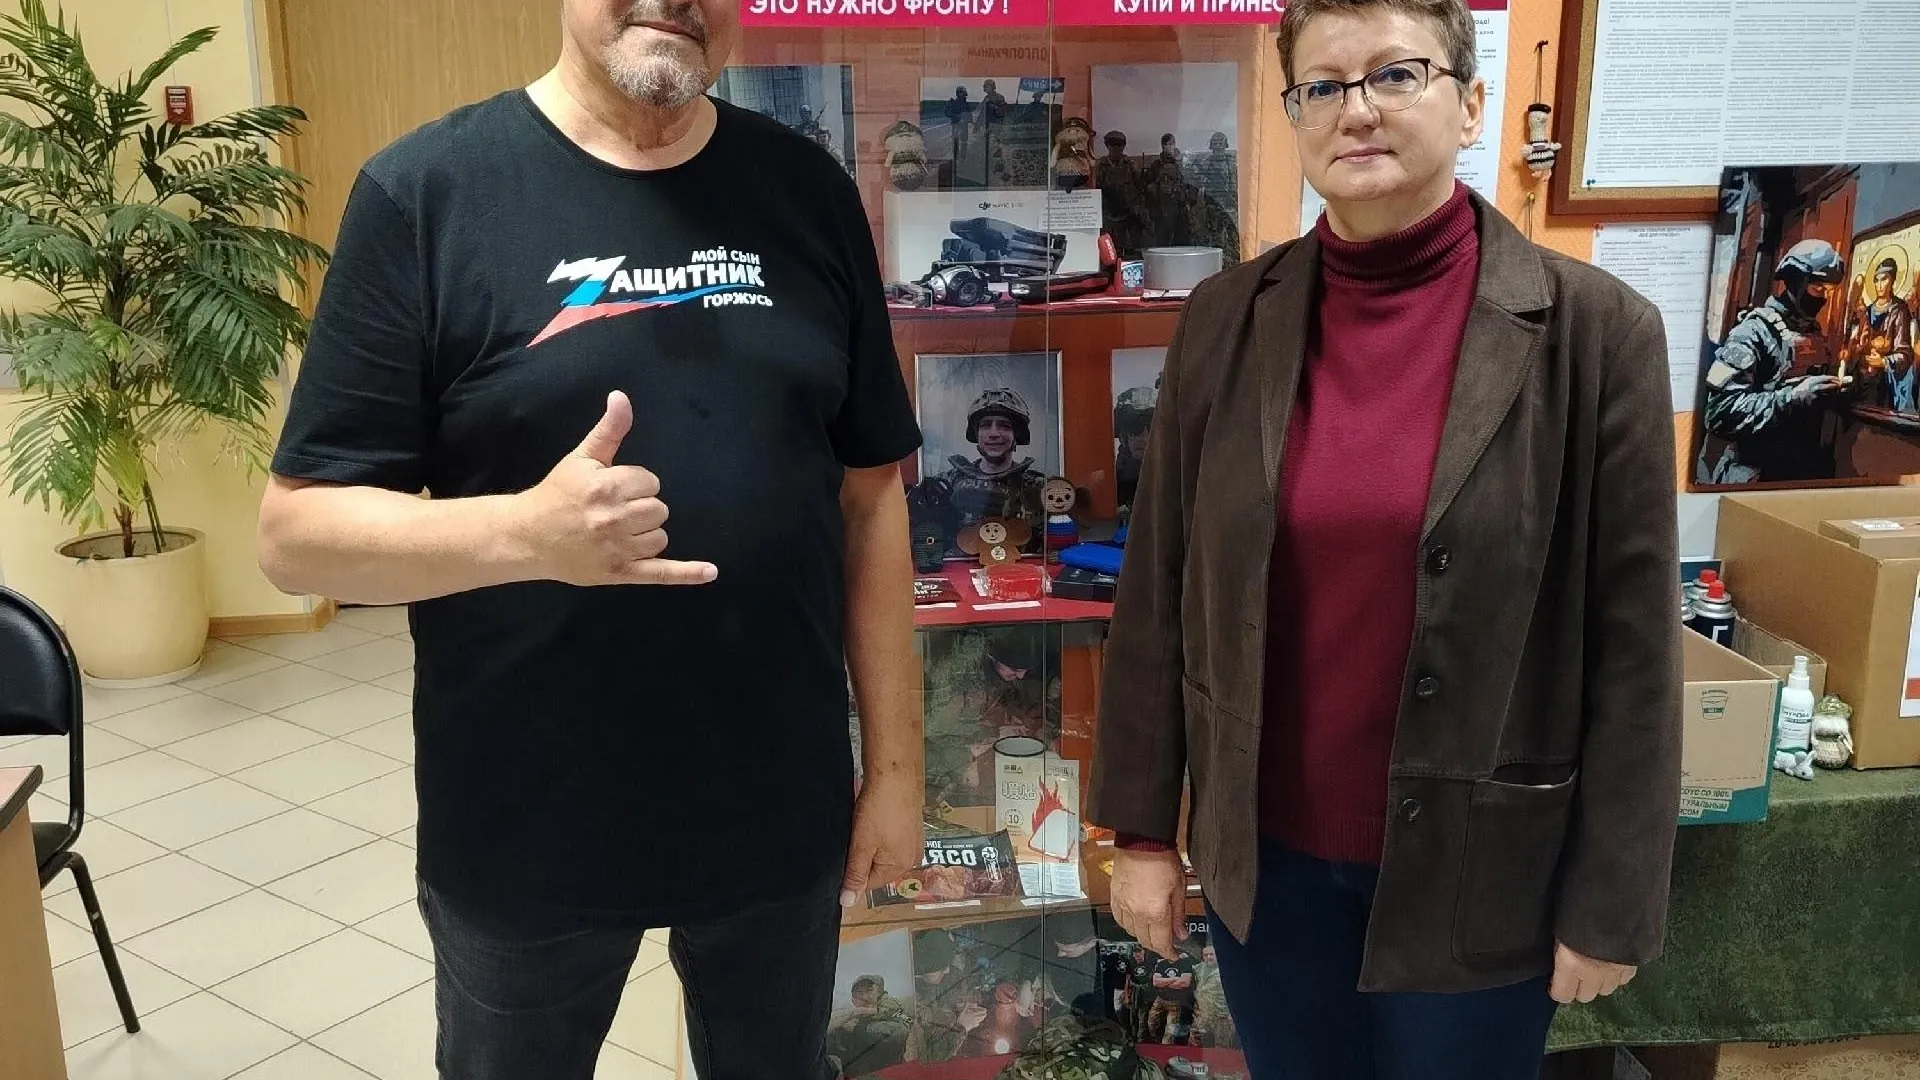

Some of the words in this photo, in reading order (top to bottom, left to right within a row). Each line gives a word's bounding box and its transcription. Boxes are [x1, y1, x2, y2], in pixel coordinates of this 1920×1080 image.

[807, 0, 897, 15] НУЖНО
[904, 0, 994, 15] ФРОНТУ
[1113, 0, 1173, 13] КУПИ
[1181, 0, 1195, 13] И
[1202, 0, 1287, 13] ПРИНЕС
[691, 246, 728, 264] МОЙ
[729, 250, 760, 265] СЫН
[703, 292, 774, 309] ГОРЖУСЬ
[1681, 798, 1728, 810] ТУРАЛЬНЫМ
[1008, 814, 1019, 824] 10
